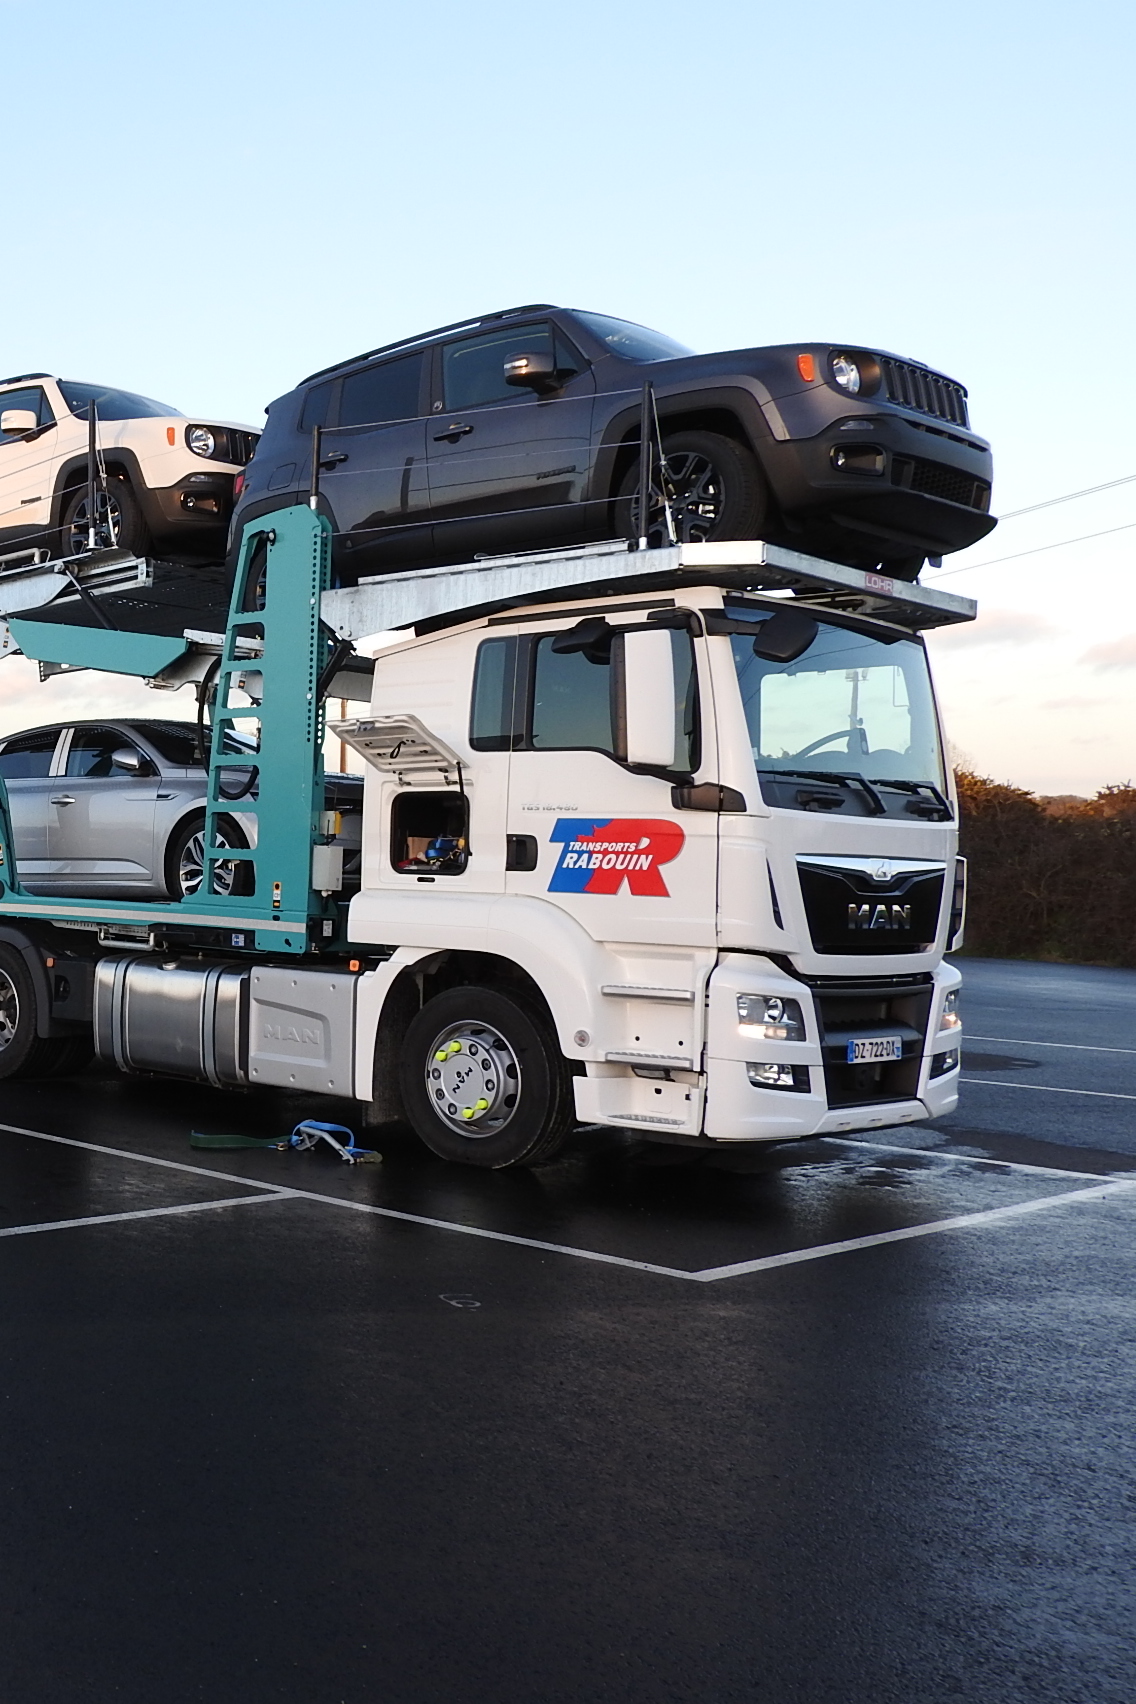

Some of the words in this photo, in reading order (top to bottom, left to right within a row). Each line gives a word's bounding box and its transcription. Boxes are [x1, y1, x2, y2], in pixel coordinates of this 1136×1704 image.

[866, 575, 893, 592] LOHR
[568, 841, 637, 852] TRANSPORTS
[562, 853, 653, 870] RABOUIN
[848, 903, 911, 929] MAN
[263, 1023, 319, 1045] MAN
[854, 1040, 895, 1059] DZ-722-DX
[452, 1066, 473, 1094] MAN
